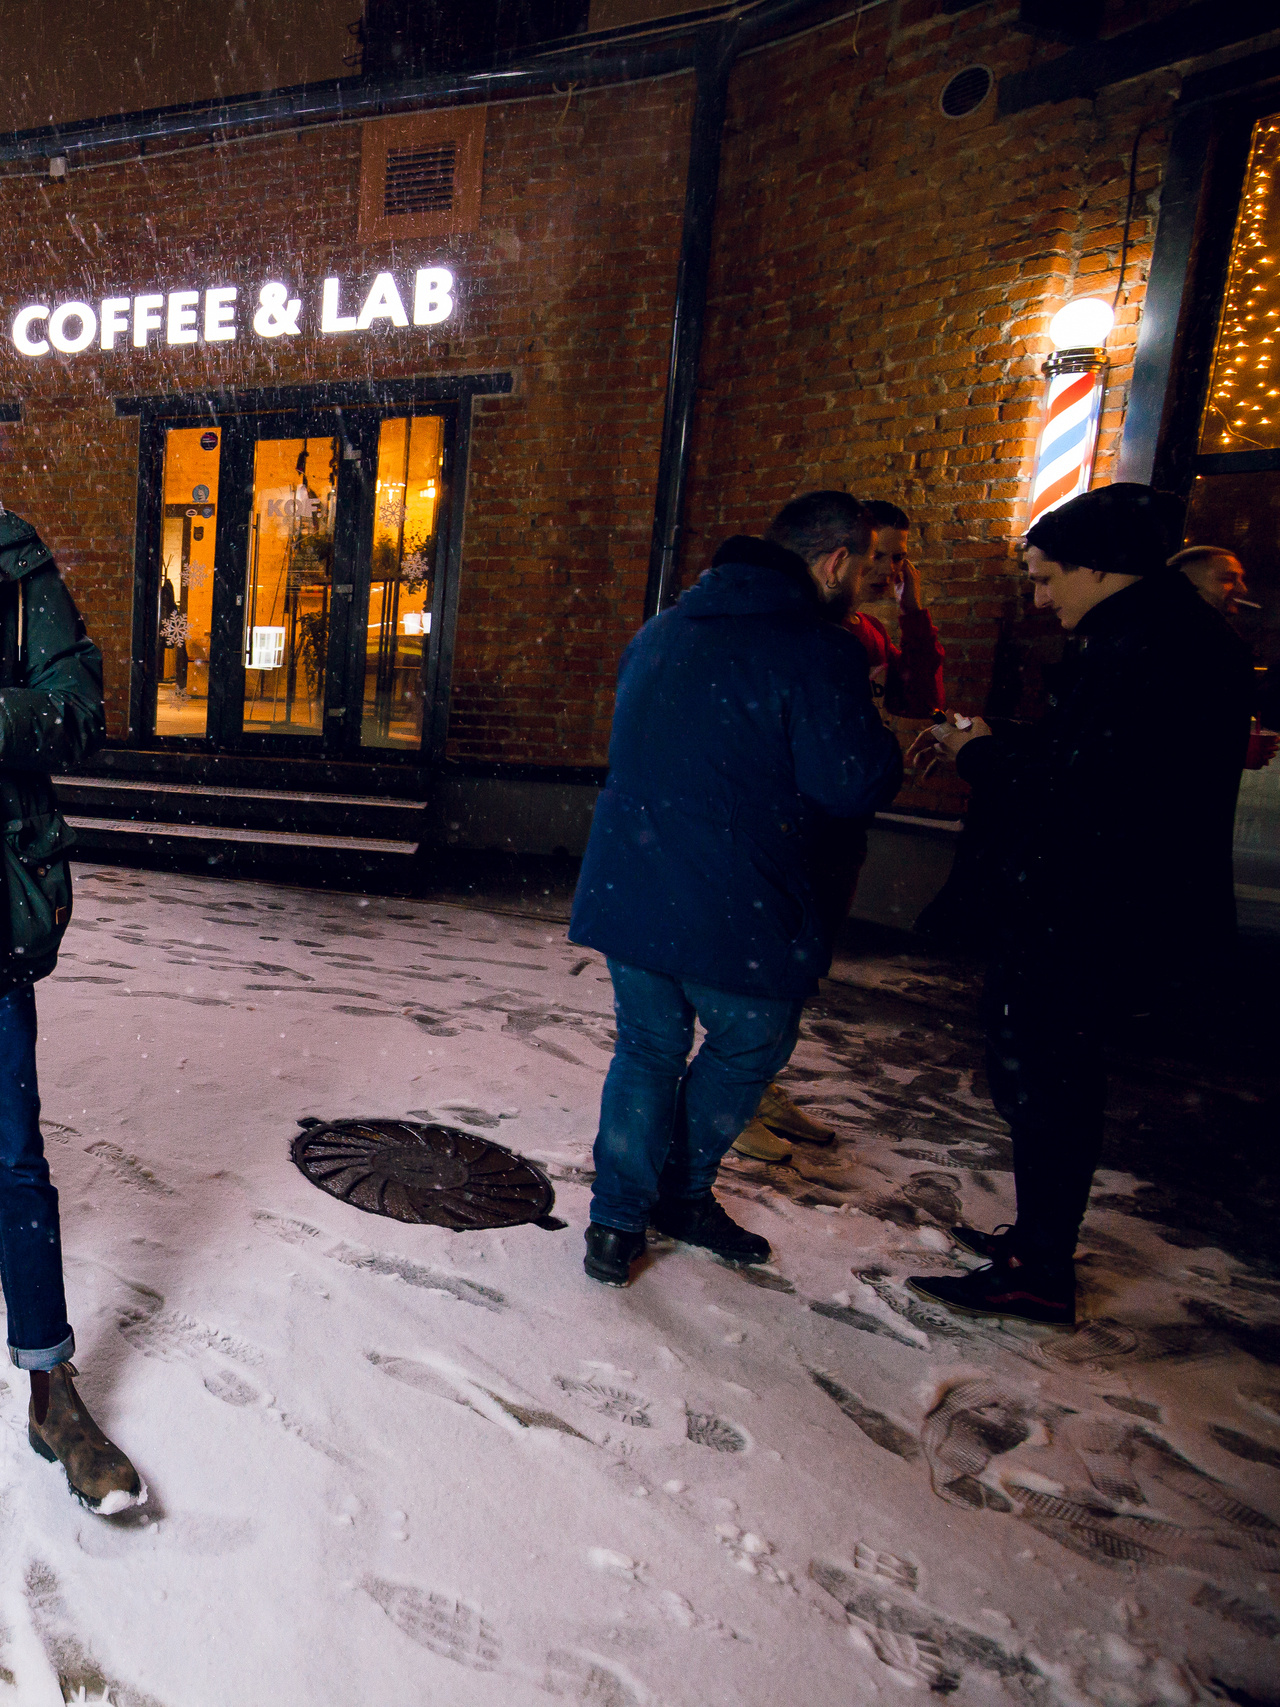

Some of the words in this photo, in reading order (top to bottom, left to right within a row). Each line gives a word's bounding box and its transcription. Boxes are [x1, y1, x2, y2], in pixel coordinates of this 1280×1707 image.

[12, 287, 237, 356] COFFEE
[253, 282, 302, 338] &
[321, 267, 454, 333] LAB
[267, 498, 322, 518] KOF.
